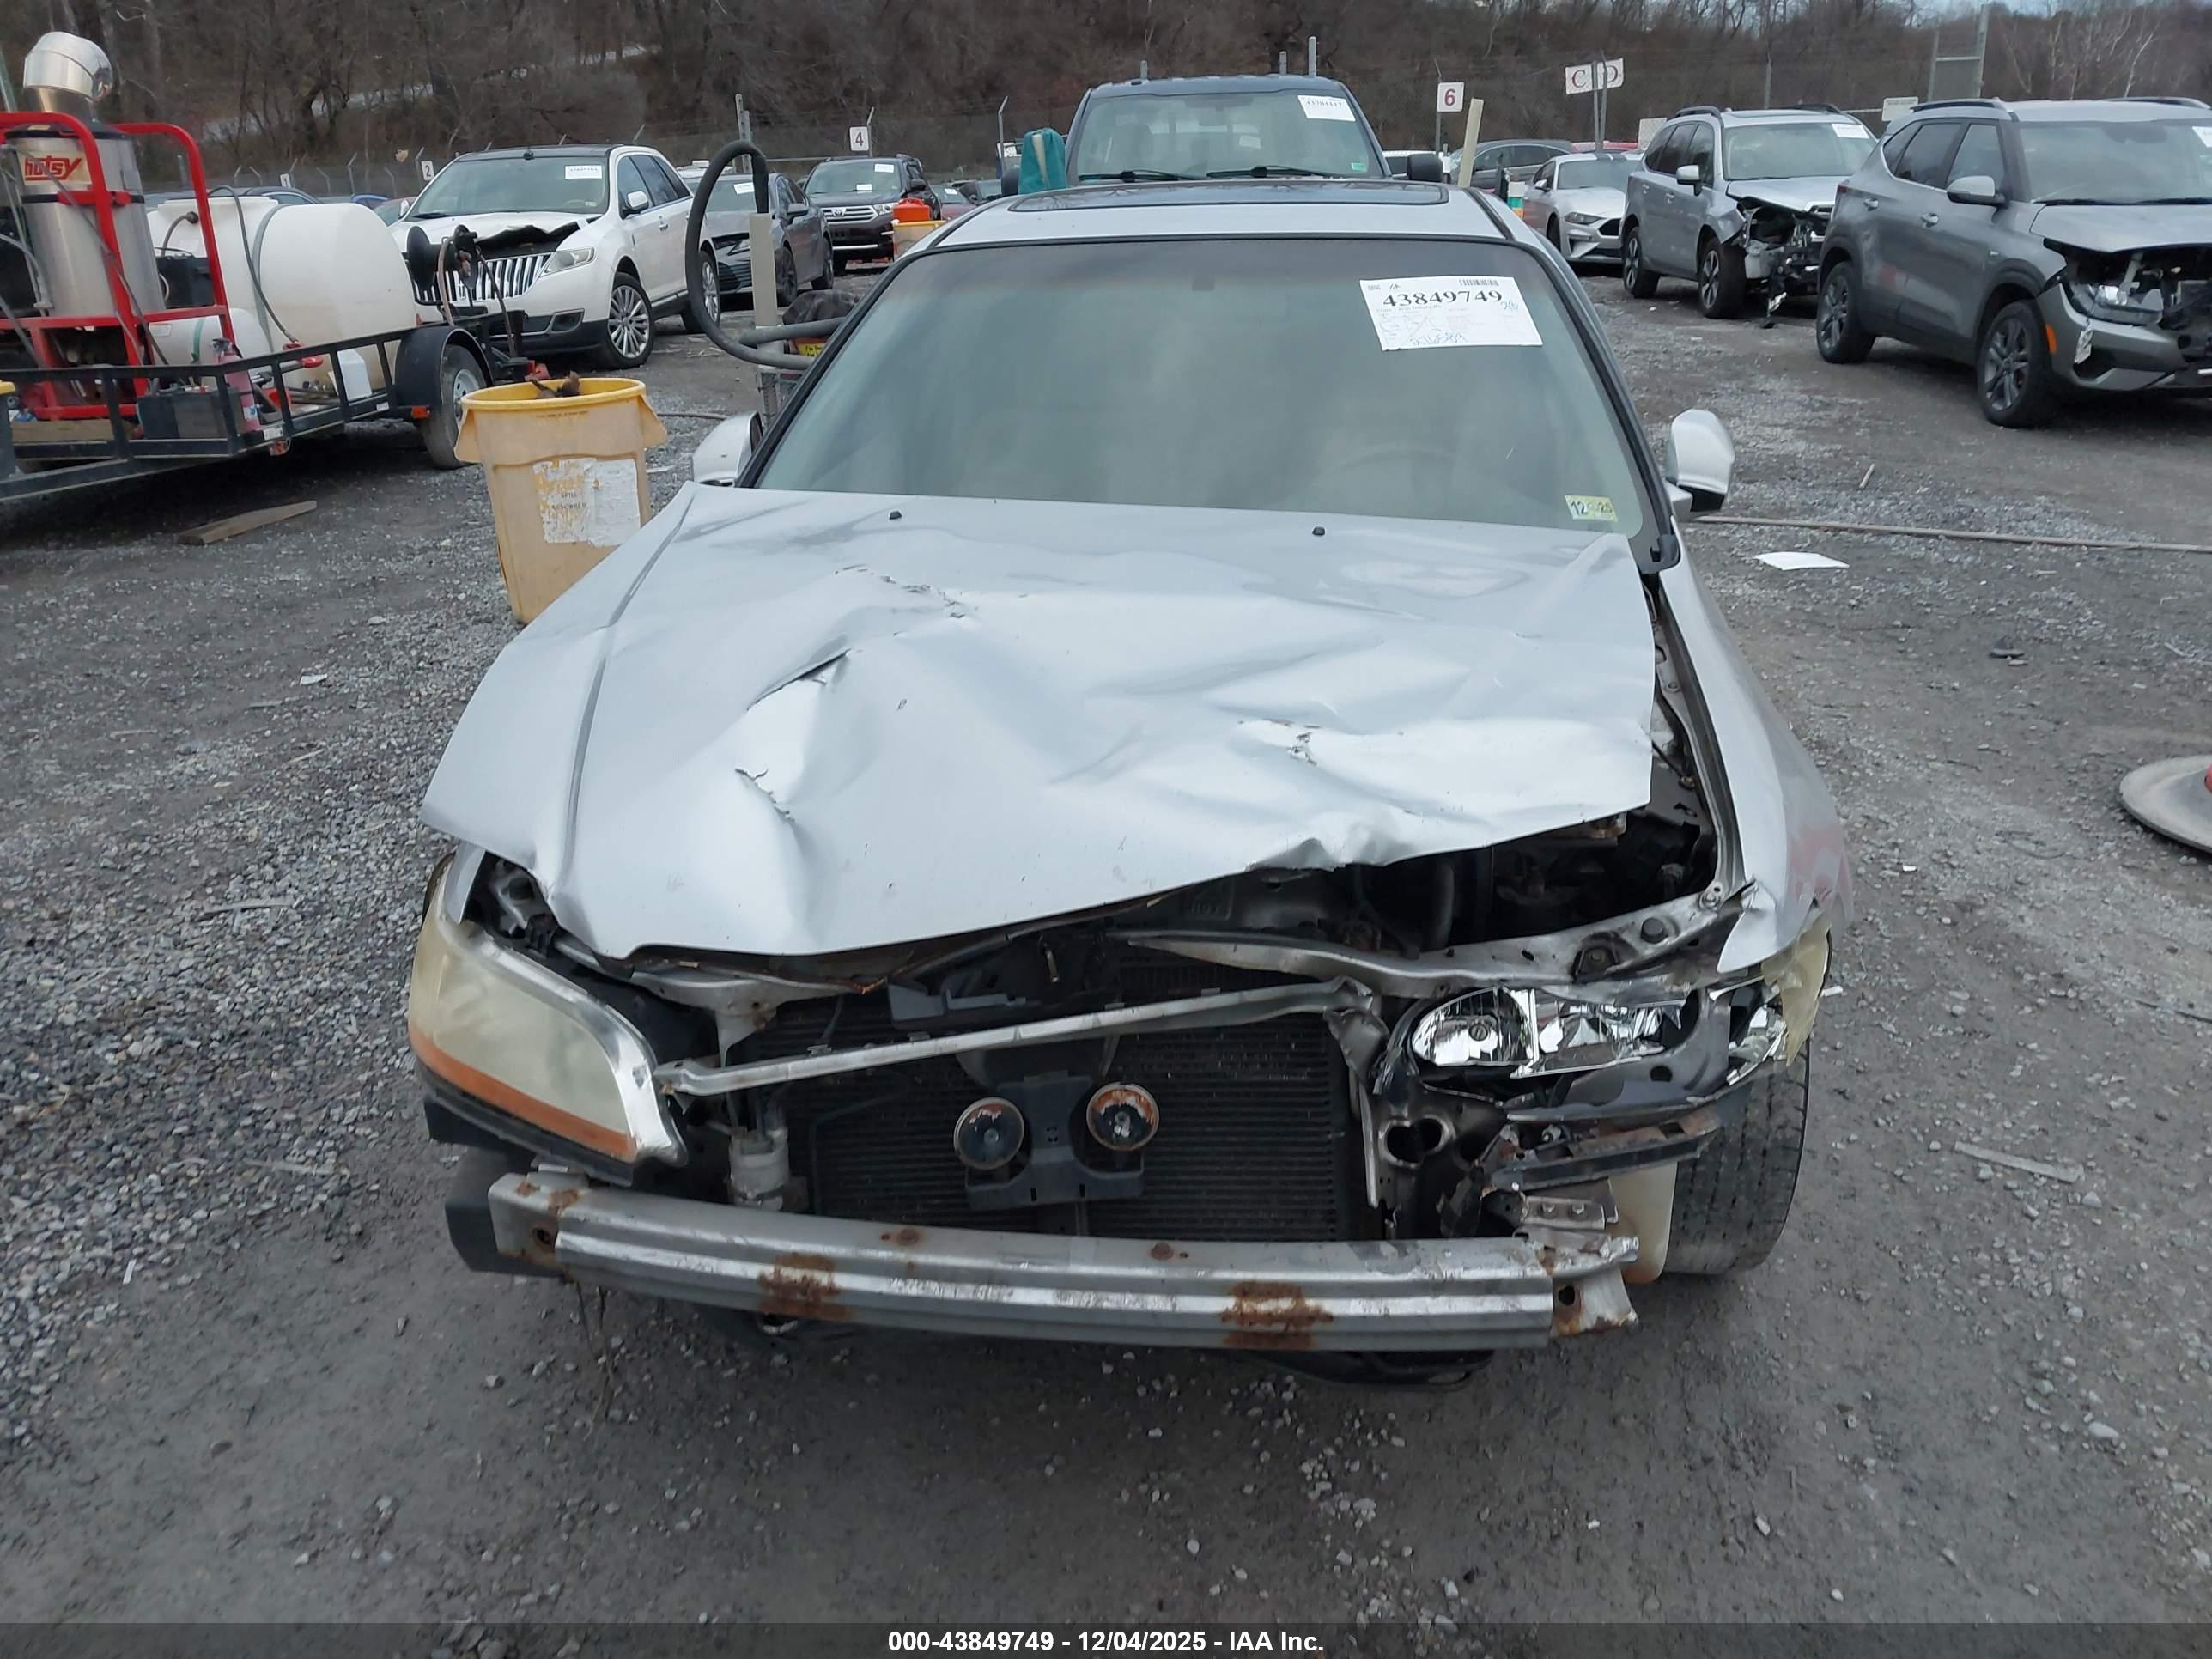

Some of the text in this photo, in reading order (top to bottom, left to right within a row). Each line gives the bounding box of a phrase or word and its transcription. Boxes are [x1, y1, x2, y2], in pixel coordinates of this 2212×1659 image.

[1571, 70, 1587, 88] C
[1444, 88, 1455, 106] 6
[855, 131, 864, 147] 4
[425, 164, 432, 177] 2
[1382, 289, 1503, 307] 43849749
[1571, 501, 1589, 516] 12
